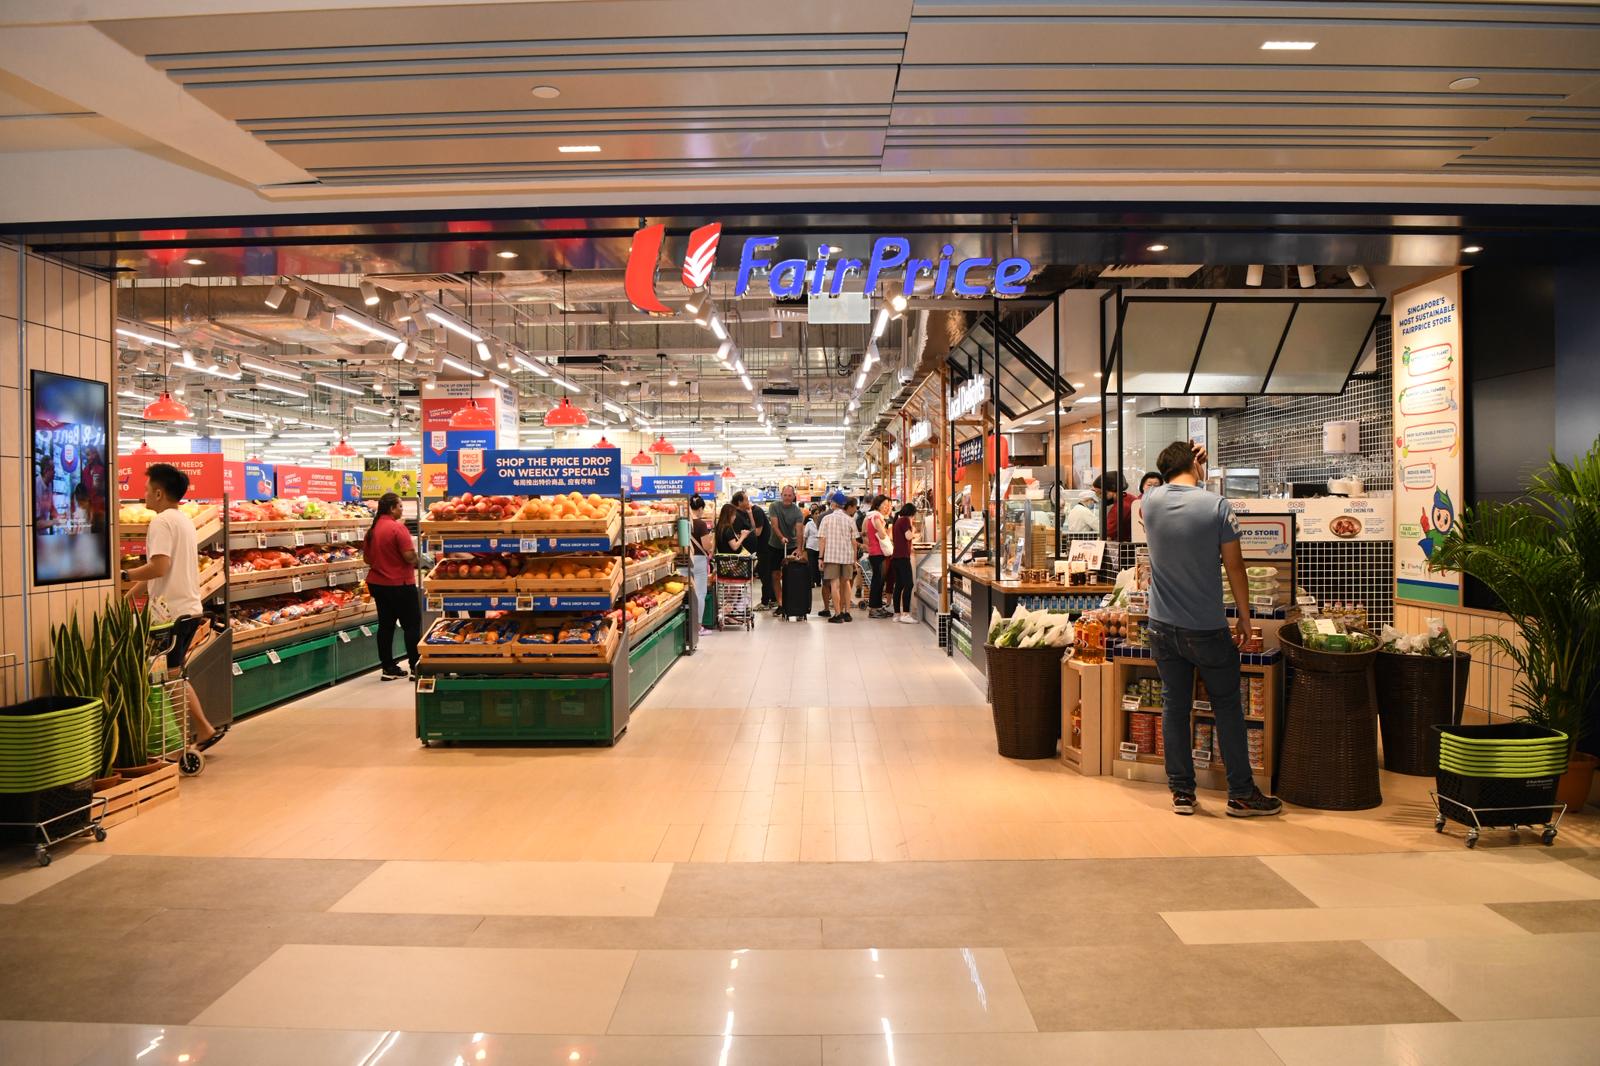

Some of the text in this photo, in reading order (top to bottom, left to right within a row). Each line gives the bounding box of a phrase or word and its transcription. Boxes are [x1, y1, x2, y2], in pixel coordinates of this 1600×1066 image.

[735, 236, 1032, 298] FairPrice
[1399, 304, 1456, 327] MOST SUSTAINABLE
[1407, 297, 1445, 315] SINGAPORE'S
[1402, 315, 1452, 336] FAIRPRICE STORE
[496, 456, 612, 467] SHOP THE PRICE DROP
[498, 467, 610, 478] ON WEEKLY SPECIALS
